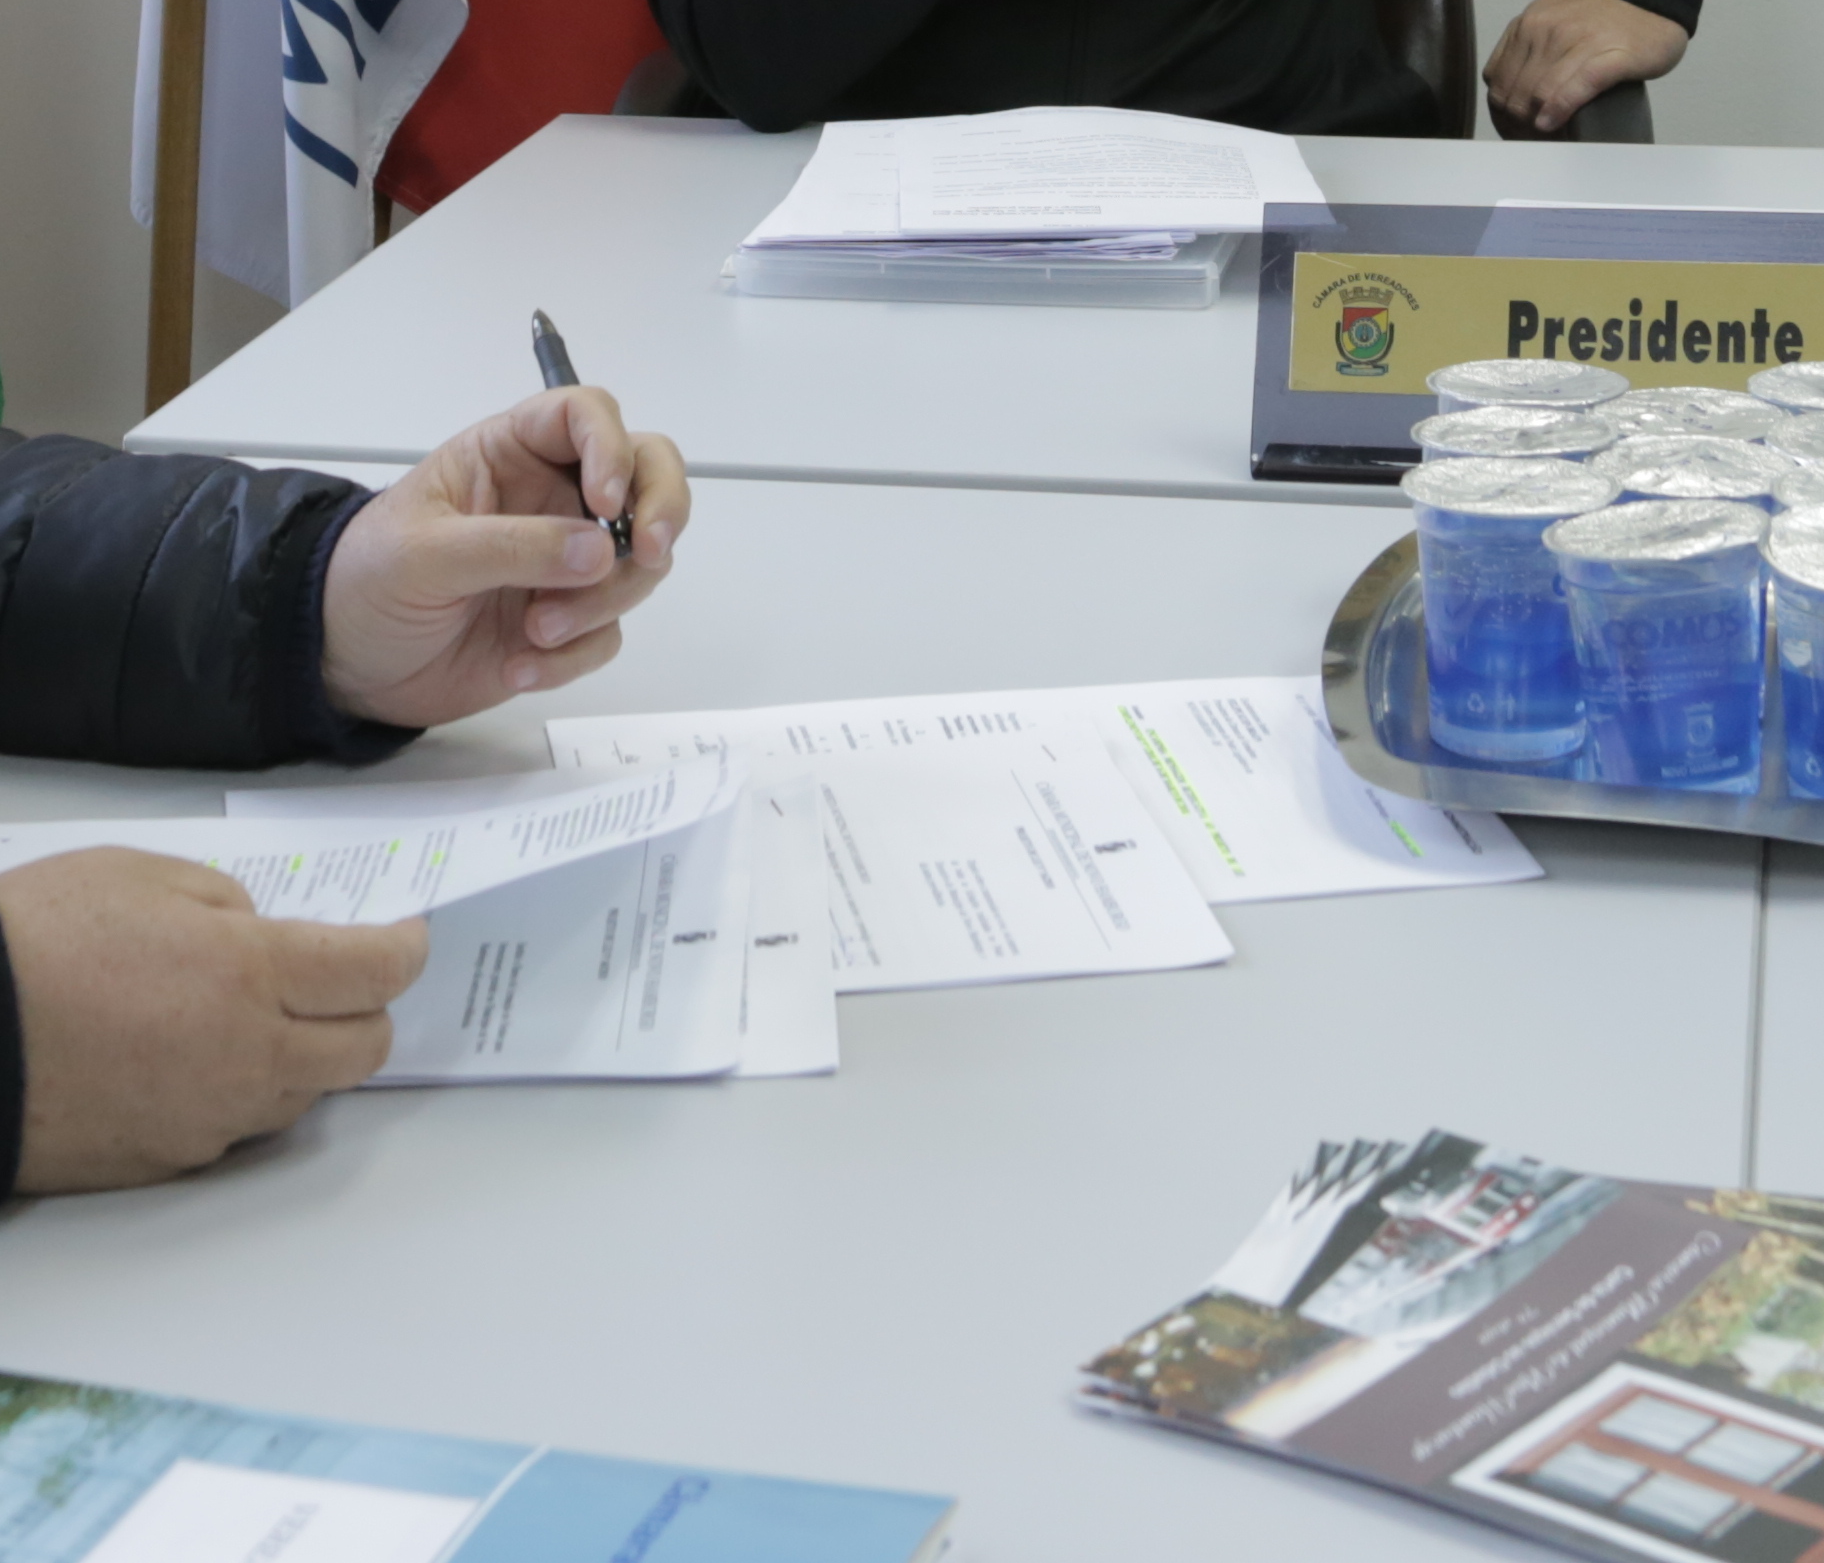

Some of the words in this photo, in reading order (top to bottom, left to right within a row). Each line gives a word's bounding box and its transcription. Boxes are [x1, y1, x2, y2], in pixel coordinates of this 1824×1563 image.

[1313, 278, 1346, 309] CÂMARA
[1348, 273, 1361, 283] DE
[1364, 273, 1419, 311] VEREADORES
[1508, 298, 1804, 363] Presidente
